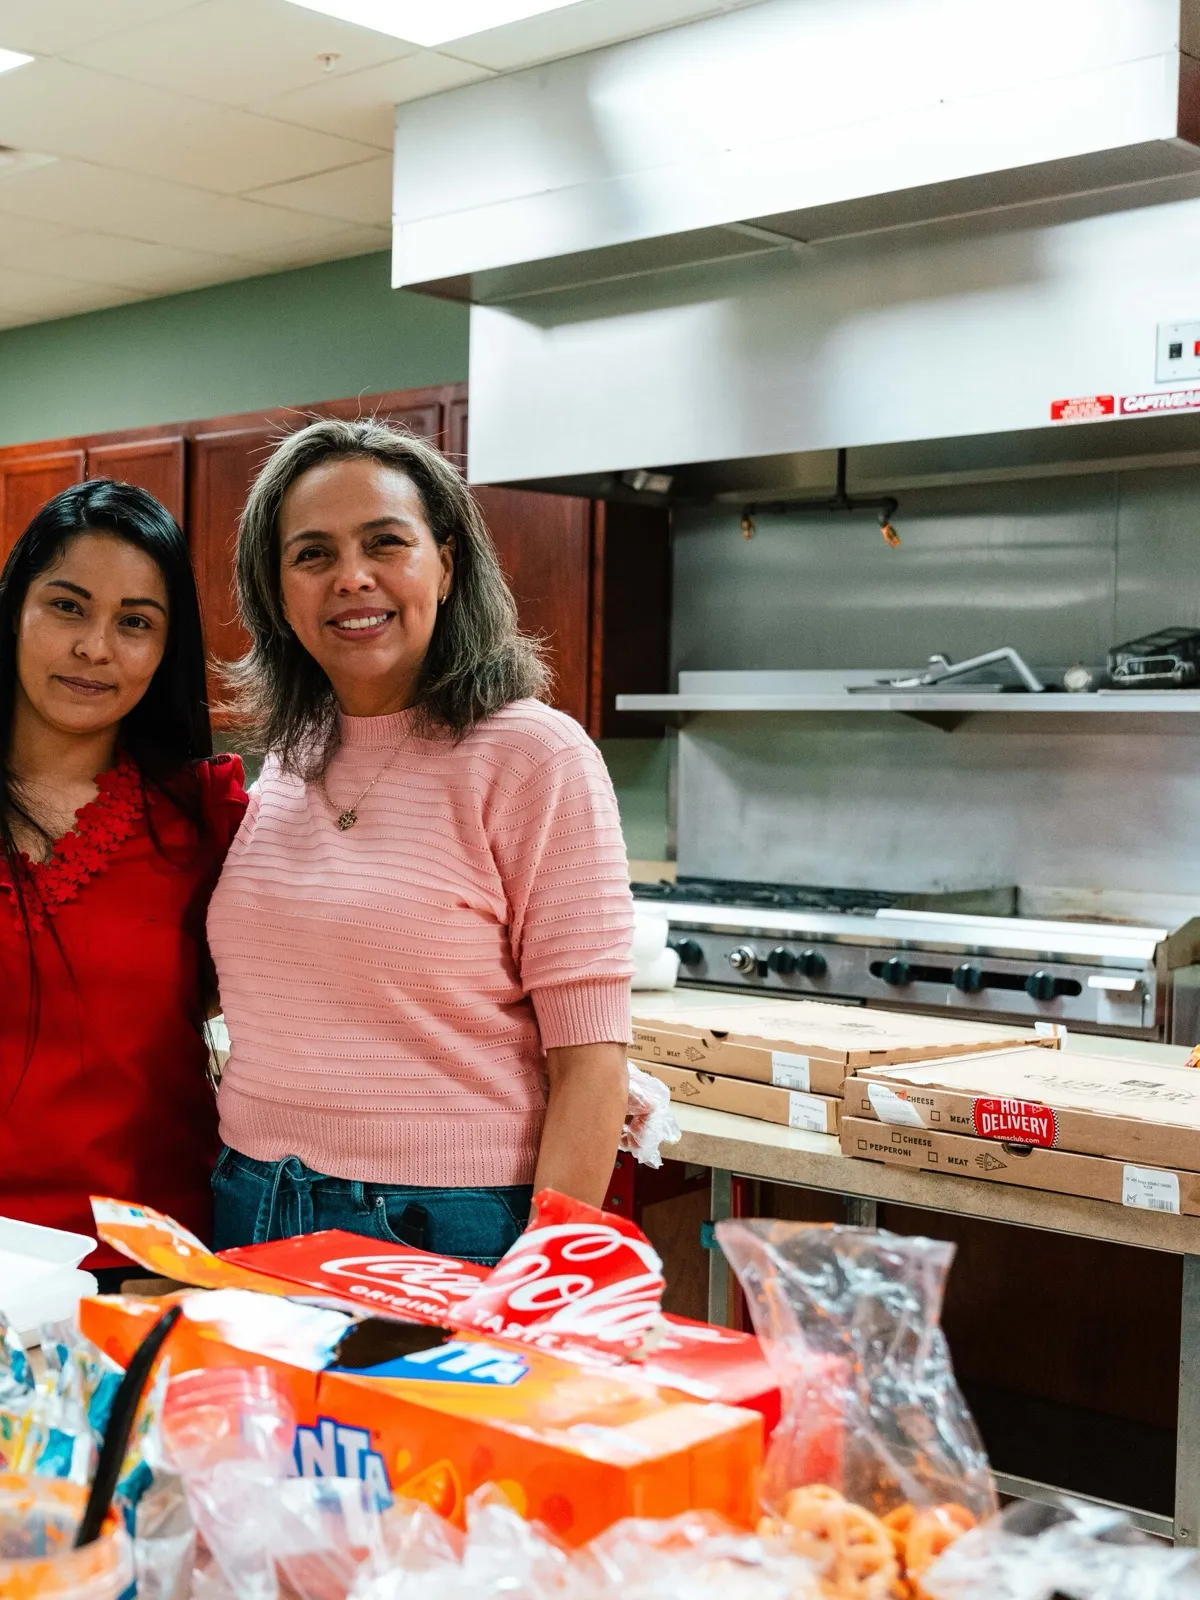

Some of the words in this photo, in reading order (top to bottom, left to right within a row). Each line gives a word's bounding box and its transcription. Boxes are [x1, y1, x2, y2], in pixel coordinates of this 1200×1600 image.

[637, 1034, 657, 1043] CHEESE
[666, 1050, 681, 1059] MEAT
[907, 1095, 935, 1106] CHEESE
[1000, 1099, 1026, 1115] HOT
[950, 1115, 970, 1125] MEAT
[981, 1112, 1048, 1138] DELIVERY
[903, 1135, 932, 1147] CHEESE
[993, 1134, 1040, 1144] samsclub.com
[869, 1143, 912, 1157] PEPPERONI
[947, 1156, 968, 1166] MEAT
[349, 1285, 462, 1321] ORIGINAL
[474, 1308, 561, 1349] TASTE
[293, 1417, 392, 1511] NTA
